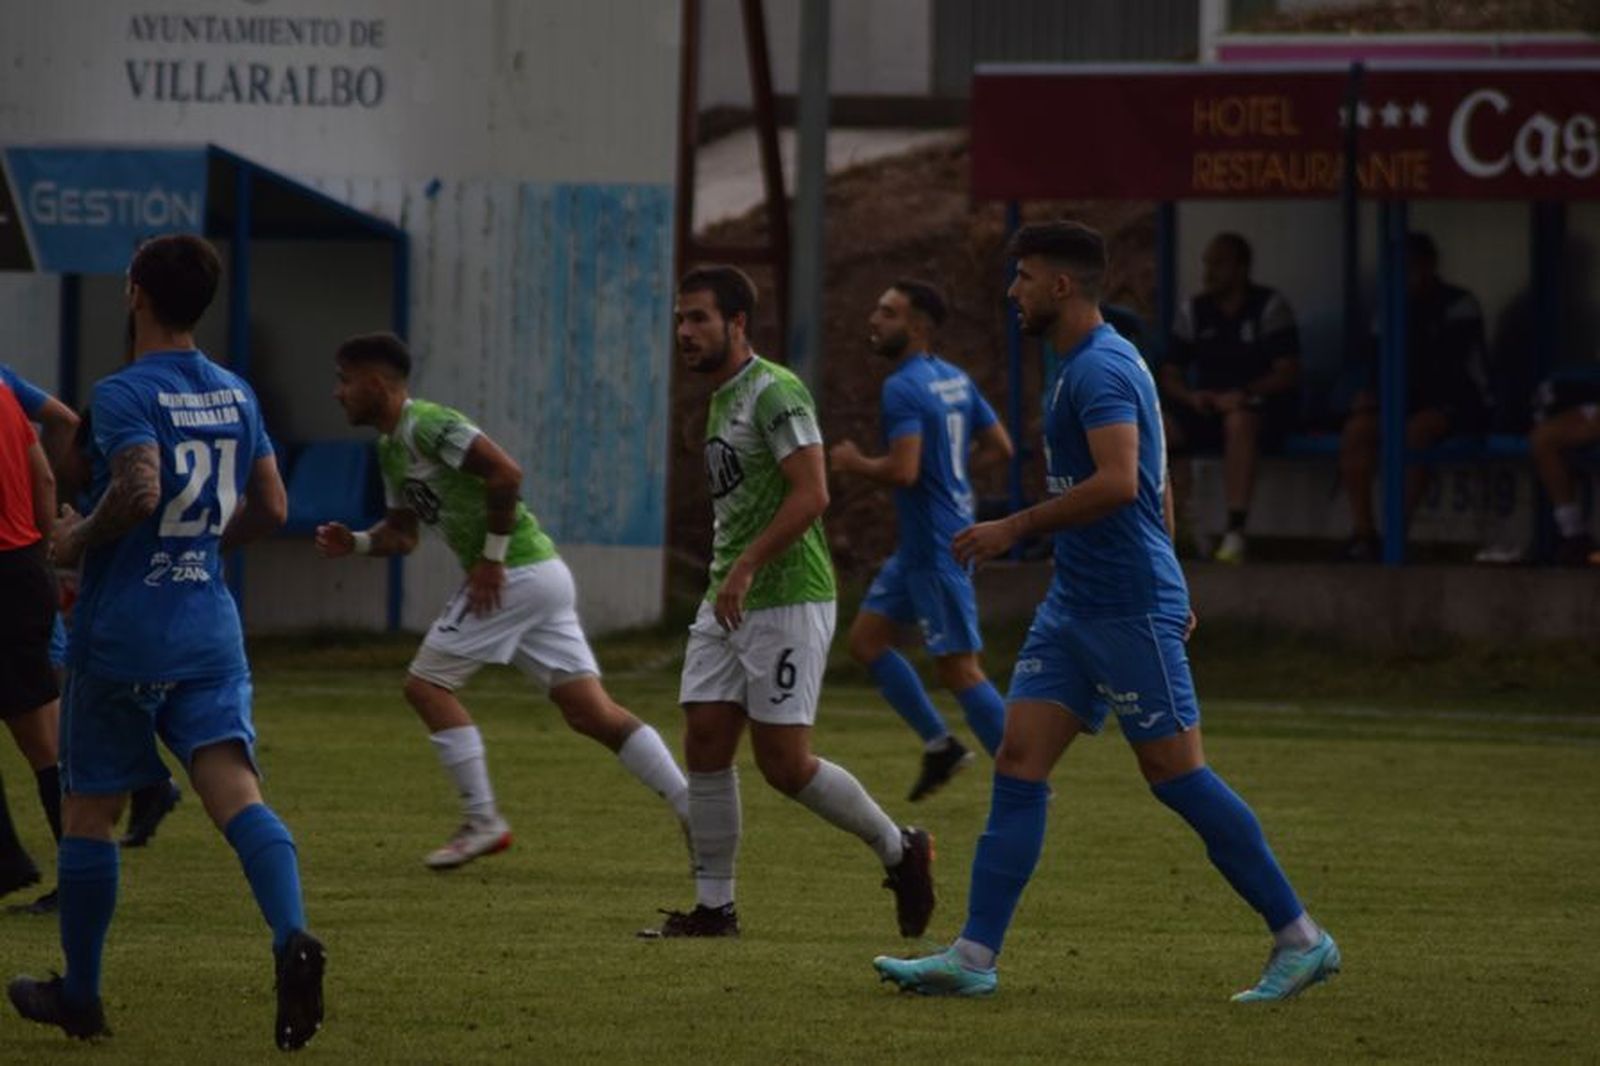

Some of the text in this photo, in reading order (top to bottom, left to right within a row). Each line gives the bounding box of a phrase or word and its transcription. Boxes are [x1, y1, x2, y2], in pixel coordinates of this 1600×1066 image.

[128, 14, 385, 48] AYUNTAMIENTO DE
[125, 60, 384, 108] VILLARALBO
[1193, 96, 1299, 136] HOTEL
[158, 438, 239, 537] 21
[777, 648, 796, 690] 6
